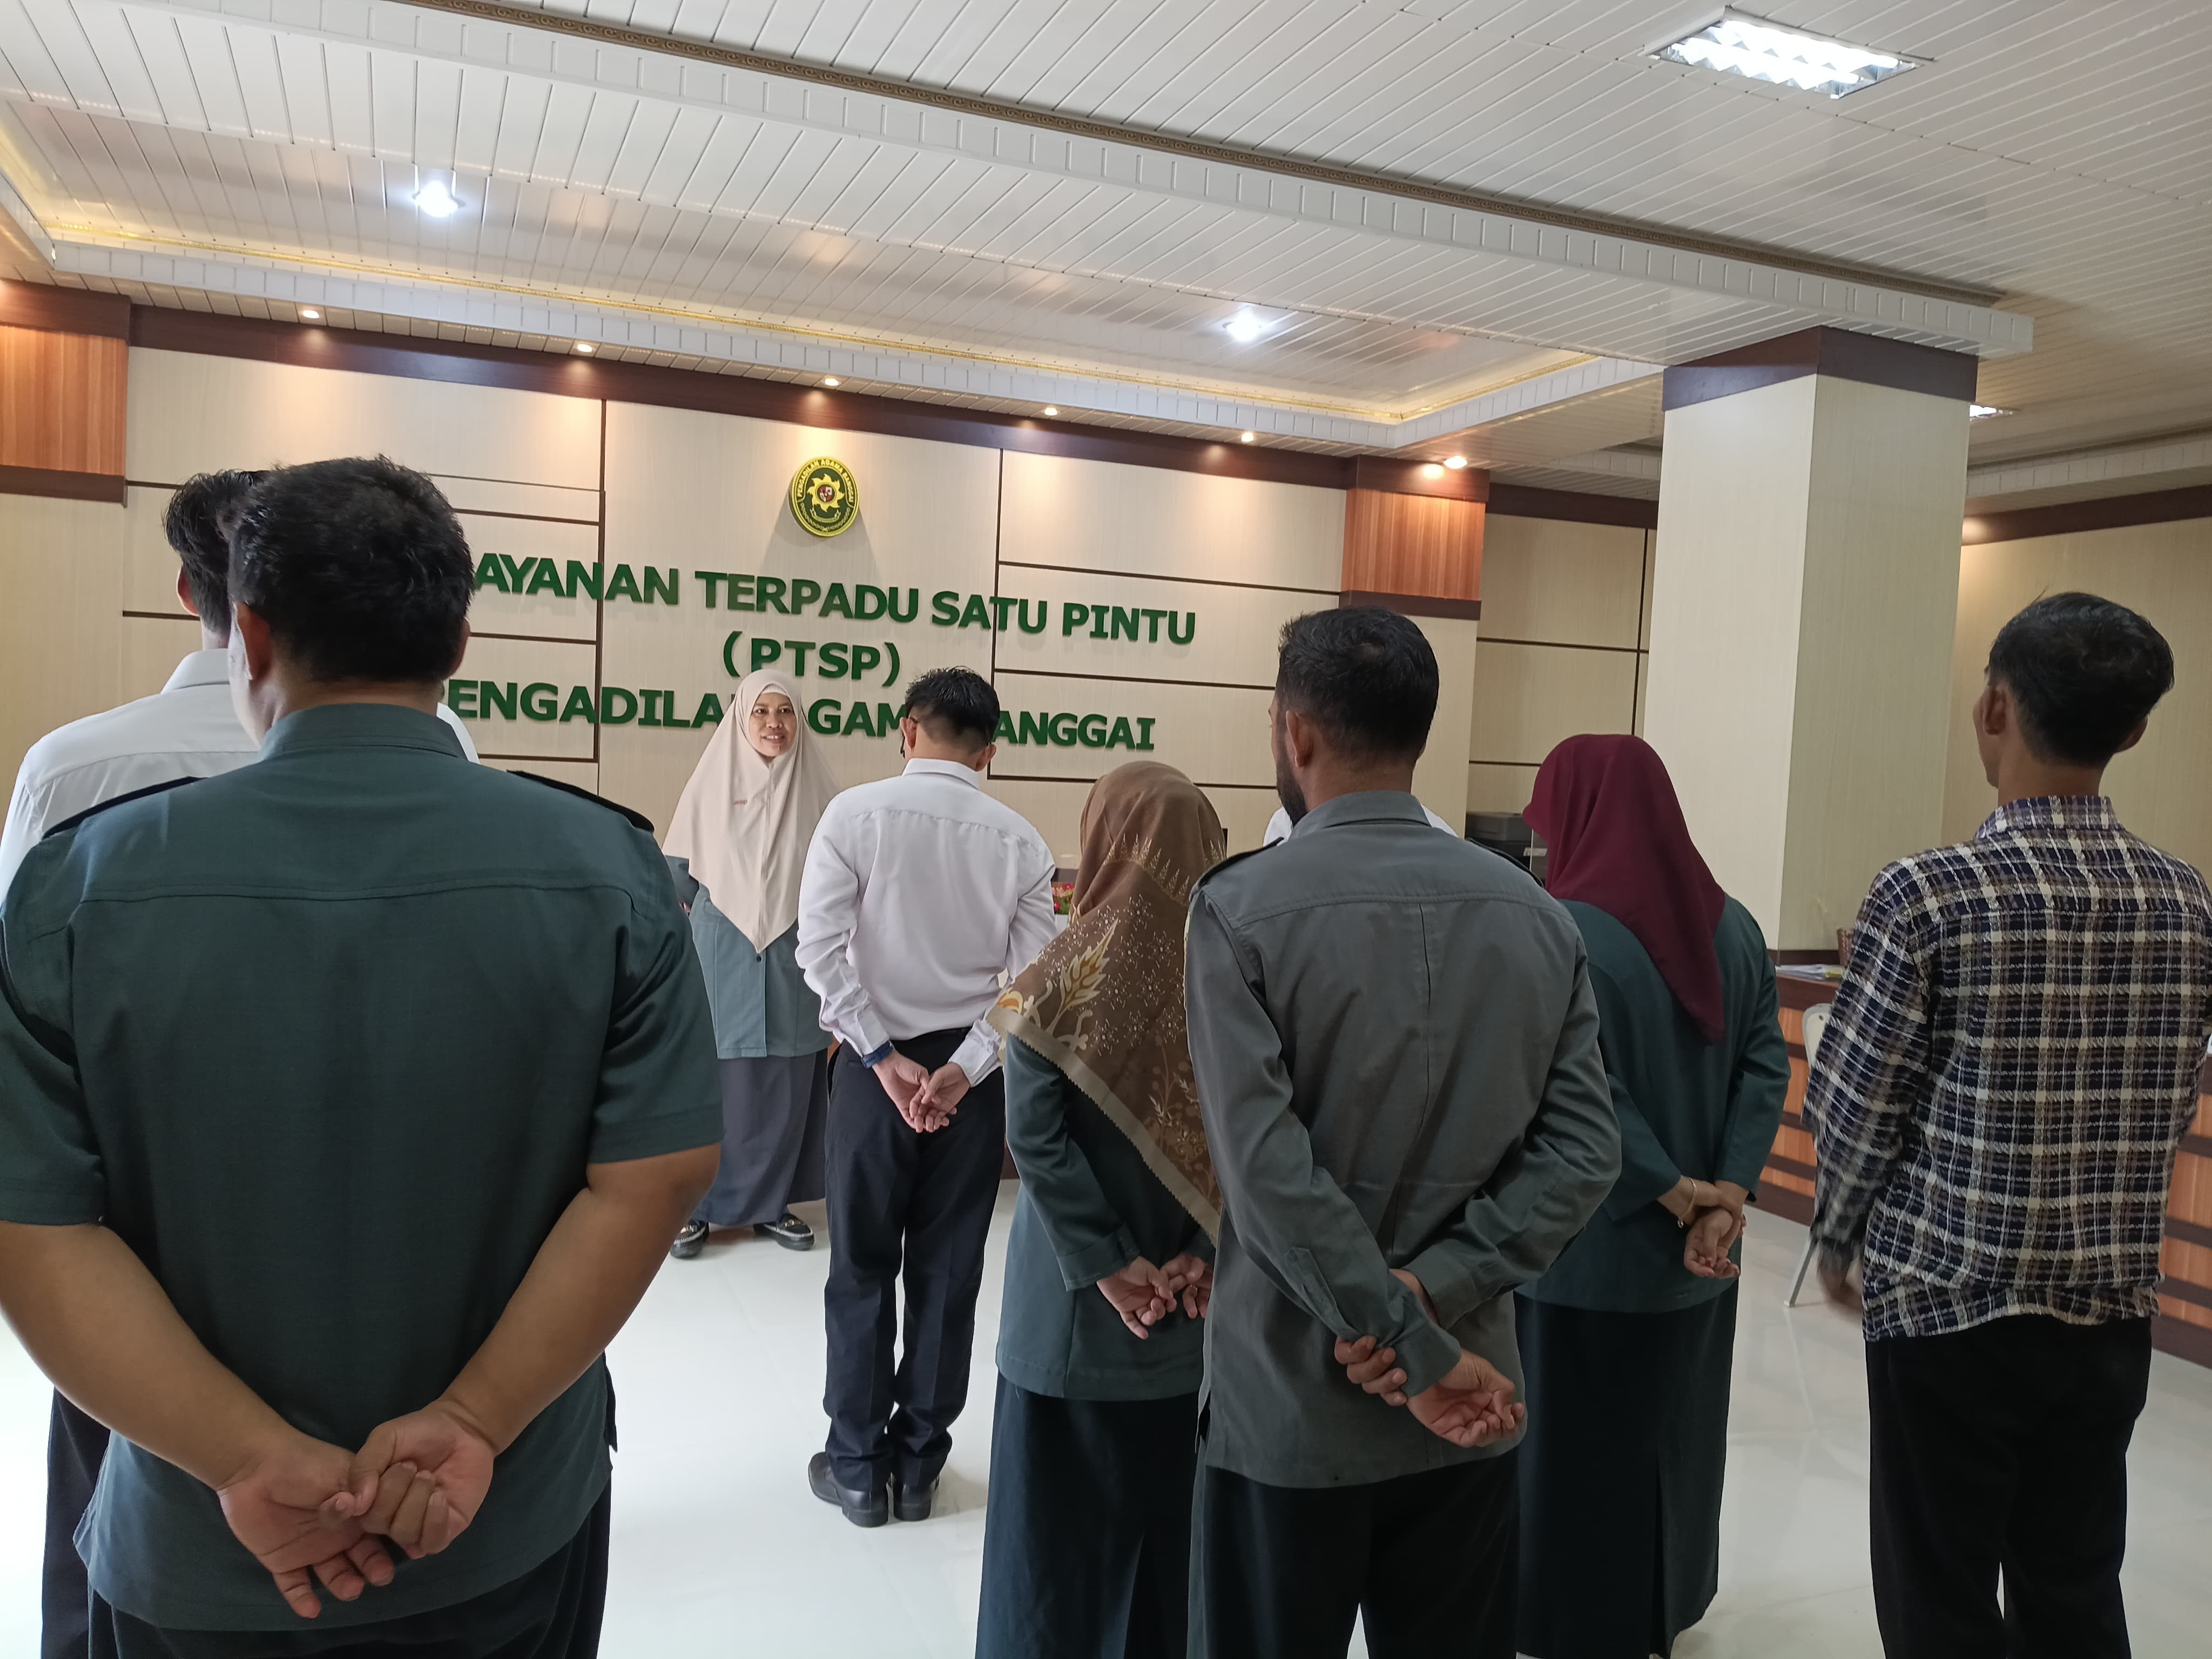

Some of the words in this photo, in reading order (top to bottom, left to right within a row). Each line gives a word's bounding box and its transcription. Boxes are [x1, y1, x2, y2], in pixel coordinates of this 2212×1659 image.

[474, 552, 679, 605] AYANAN
[694, 570, 919, 624] TERPADU
[931, 590, 1048, 634] SATU
[1062, 602, 1196, 644] PINTU
[723, 630, 901, 687] (PTSP)
[439, 678, 736, 729] ENGADILA
[808, 699, 908, 738] GAM
[992, 710, 1156, 751] ANGGAI
